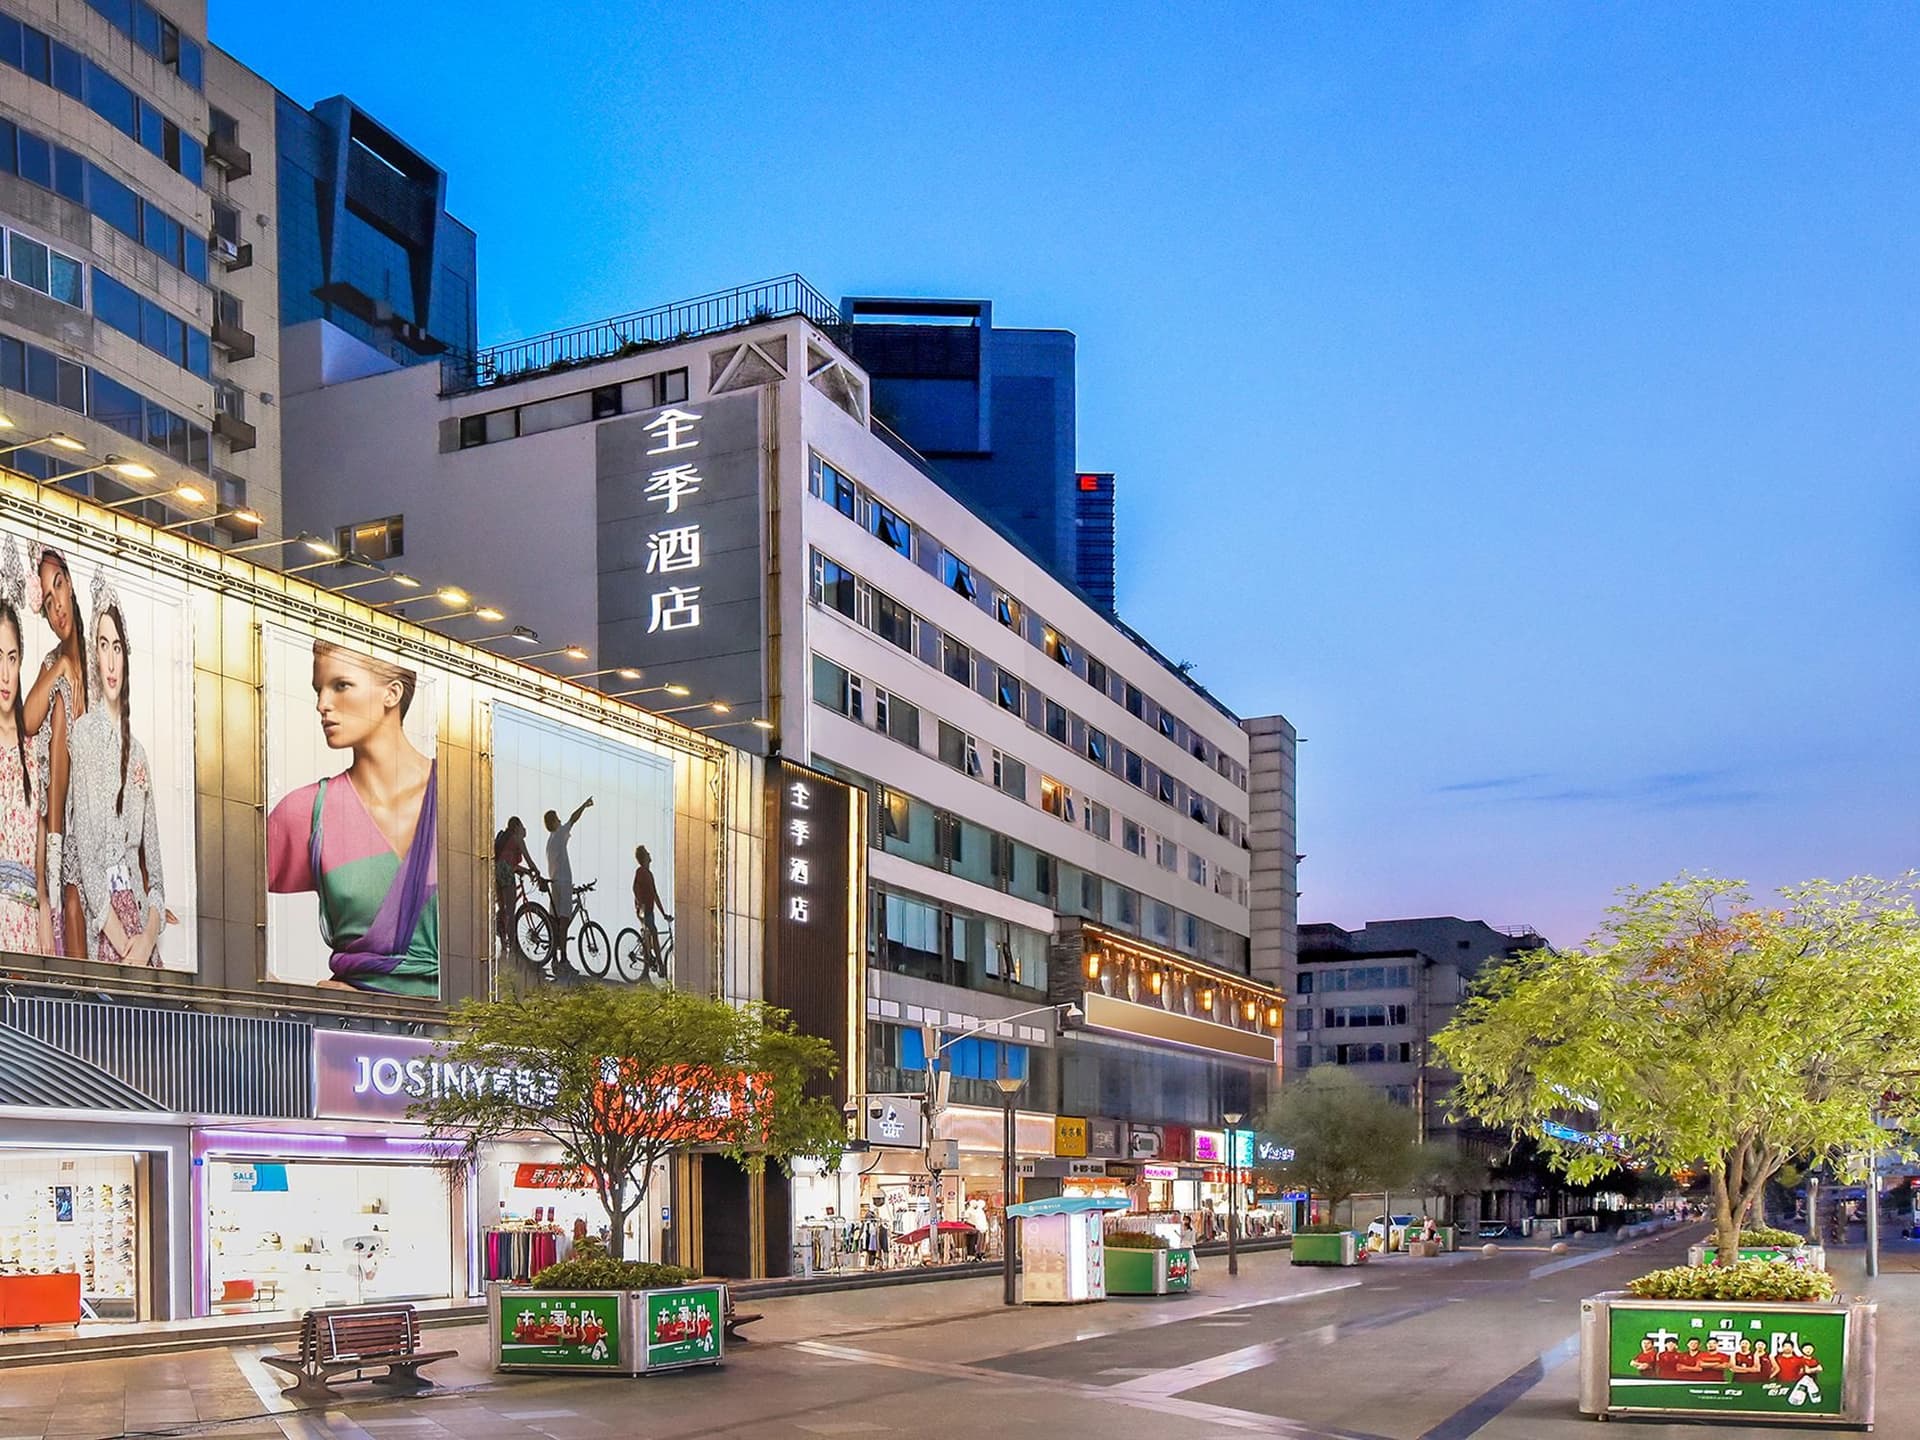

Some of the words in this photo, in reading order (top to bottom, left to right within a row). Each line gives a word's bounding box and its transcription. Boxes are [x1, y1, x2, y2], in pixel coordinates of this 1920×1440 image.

[643, 407, 704, 635] 全季酒店
[789, 781, 811, 924] 全季酒店
[353, 1056, 488, 1100] JOSINY
[233, 1172, 255, 1181] SALE
